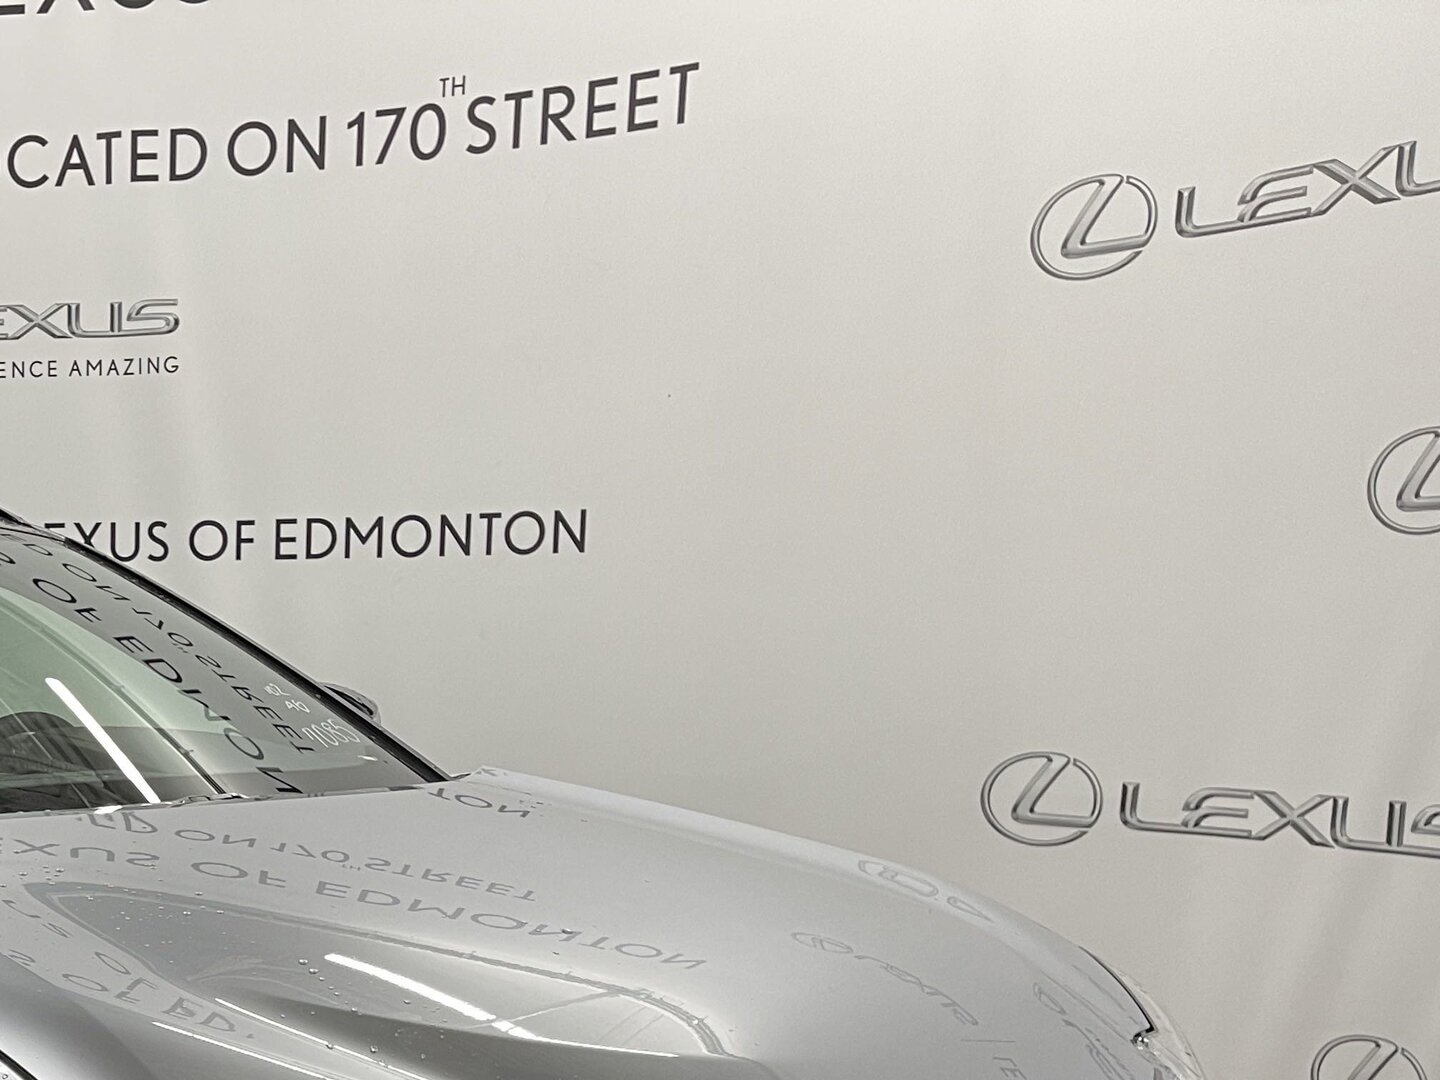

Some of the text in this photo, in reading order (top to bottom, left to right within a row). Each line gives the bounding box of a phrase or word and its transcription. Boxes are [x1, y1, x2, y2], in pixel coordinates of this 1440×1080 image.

[227, 116, 327, 176] ON
[466, 62, 699, 154] STREET
[69, 356, 179, 377] AMAZING
[44, 521, 169, 562] XUS
[189, 520, 255, 561] OF
[275, 509, 587, 560] EDMONTON
